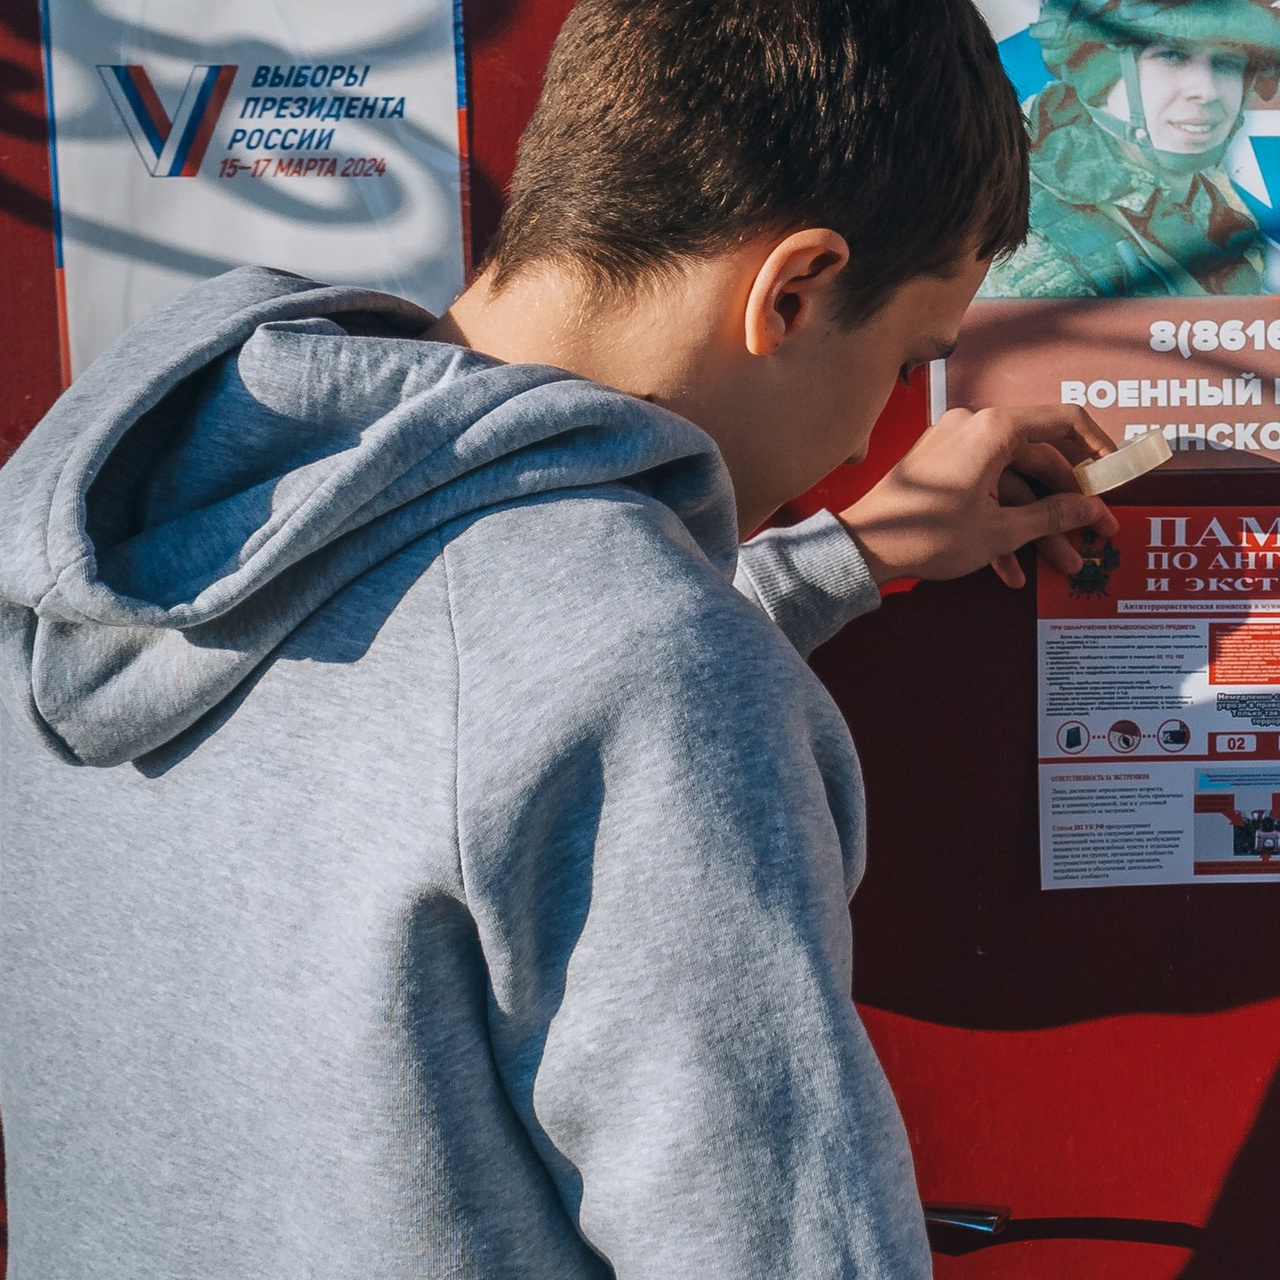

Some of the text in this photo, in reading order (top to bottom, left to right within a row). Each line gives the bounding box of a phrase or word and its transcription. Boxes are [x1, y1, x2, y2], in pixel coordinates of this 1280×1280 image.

[251, 64, 370, 89] ВЫБОРЫ
[239, 97, 406, 122] ПРЕЗИДЕНТА
[227, 128, 336, 151] РОССИИ
[273, 158, 338, 178] МАРТА
[341, 157, 387, 177] 2024
[1061, 373, 1262, 409] ВОЕННЫЙ
[1146, 551, 1199, 571] ПО
[1227, 737, 1246, 750] 02
